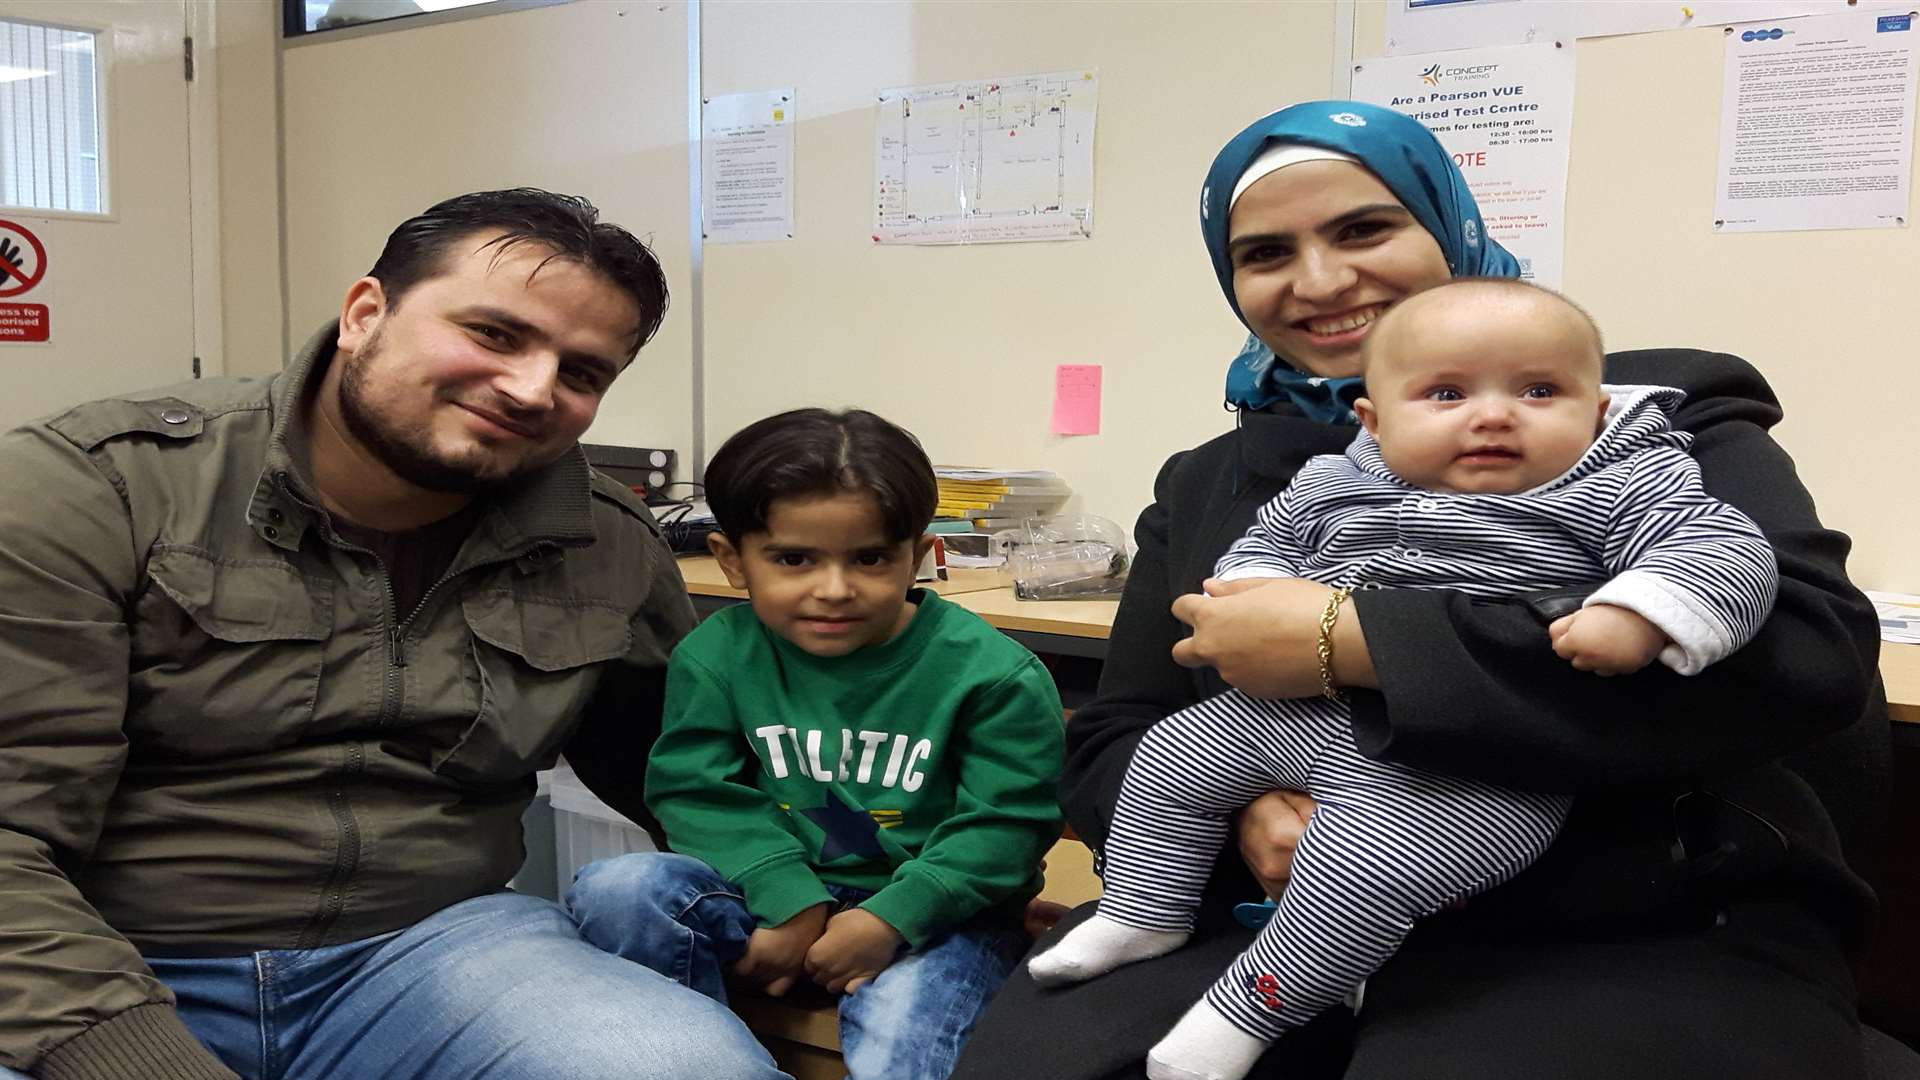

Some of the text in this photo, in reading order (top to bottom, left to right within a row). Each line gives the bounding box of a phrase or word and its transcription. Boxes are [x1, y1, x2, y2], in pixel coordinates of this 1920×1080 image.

[1445, 65, 1500, 77] CONCEPT
[1454, 73, 1490, 81] TRAINING
[1391, 86, 1524, 106] Are a Pearson VUE
[1408, 103, 1538, 121] orised Test Centre
[1430, 118, 1535, 133] mes for testing are:
[1452, 151, 1487, 168] OTE
[24, 308, 40, 317] for
[0, 318, 40, 326] orised
